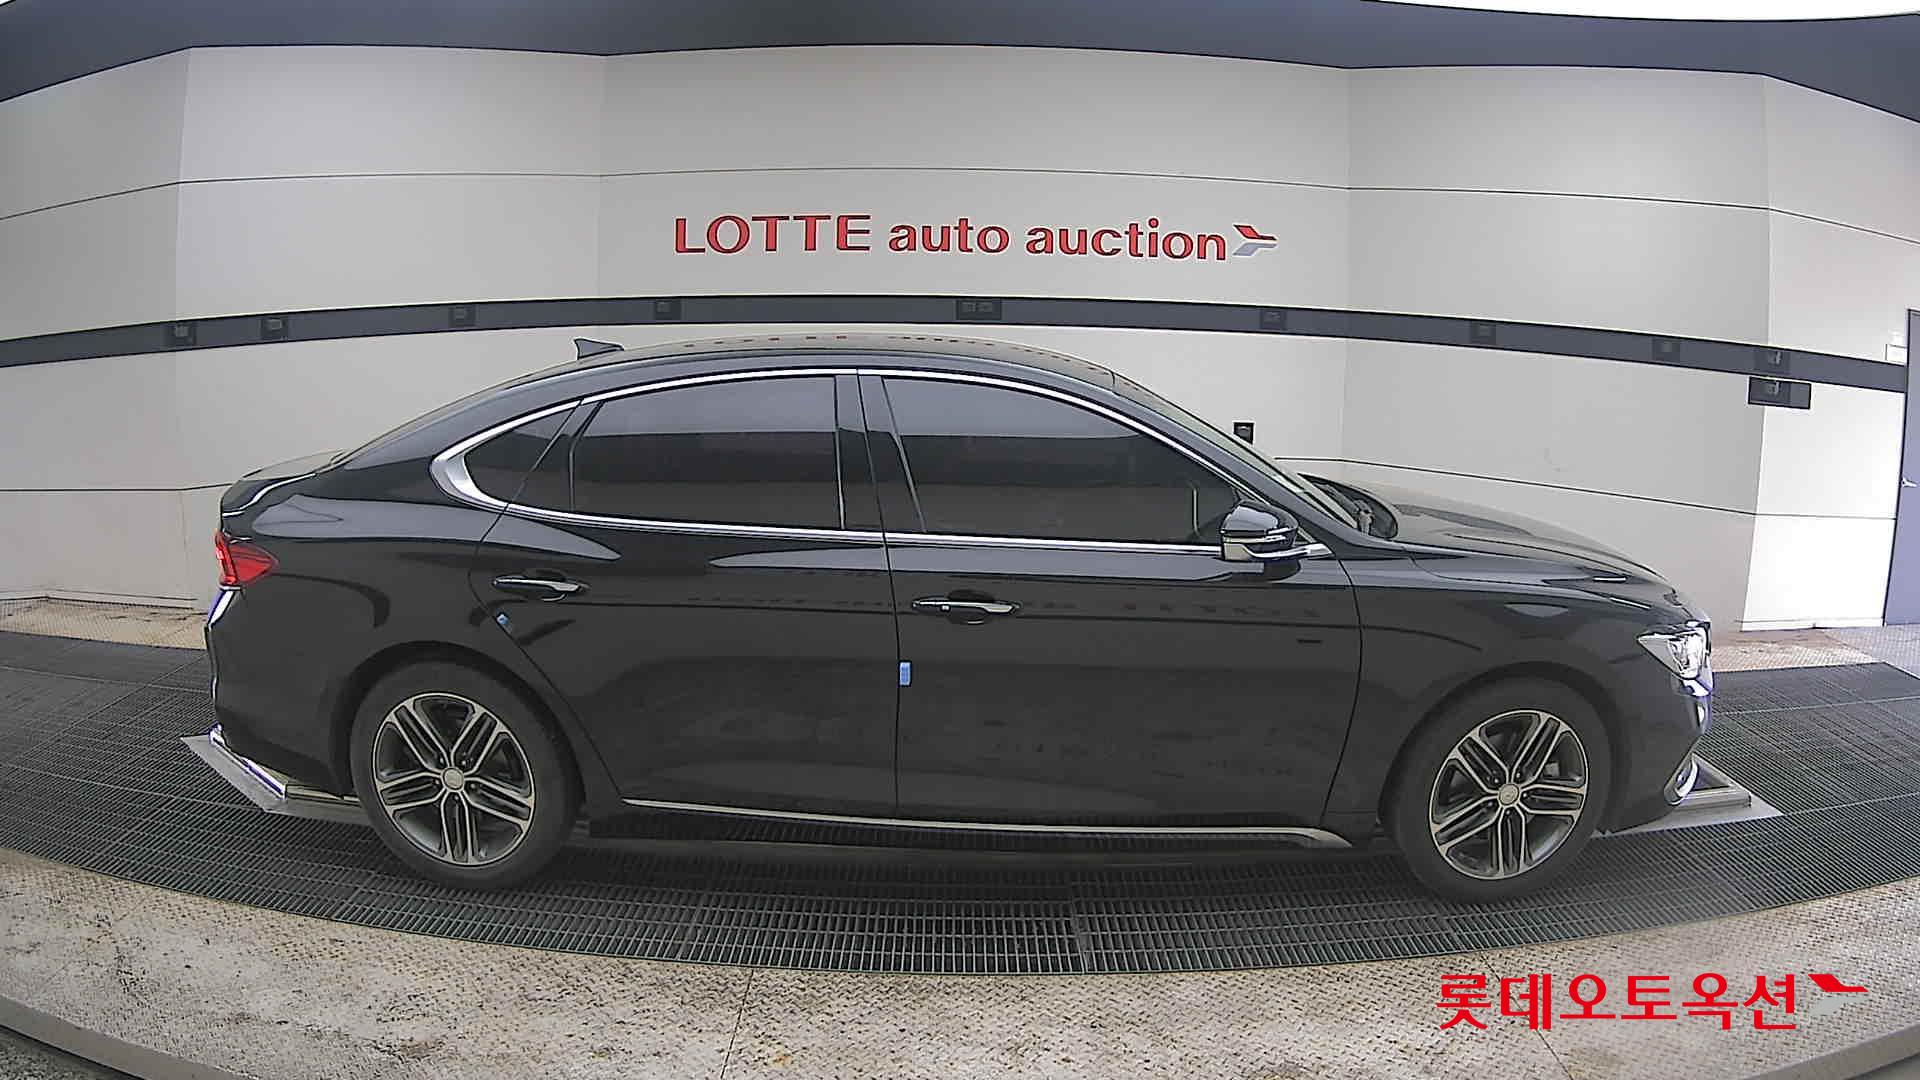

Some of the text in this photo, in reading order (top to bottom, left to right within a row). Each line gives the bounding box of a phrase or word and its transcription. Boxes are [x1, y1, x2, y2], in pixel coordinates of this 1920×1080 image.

[674, 214, 1227, 261] LOTTE auto auction
